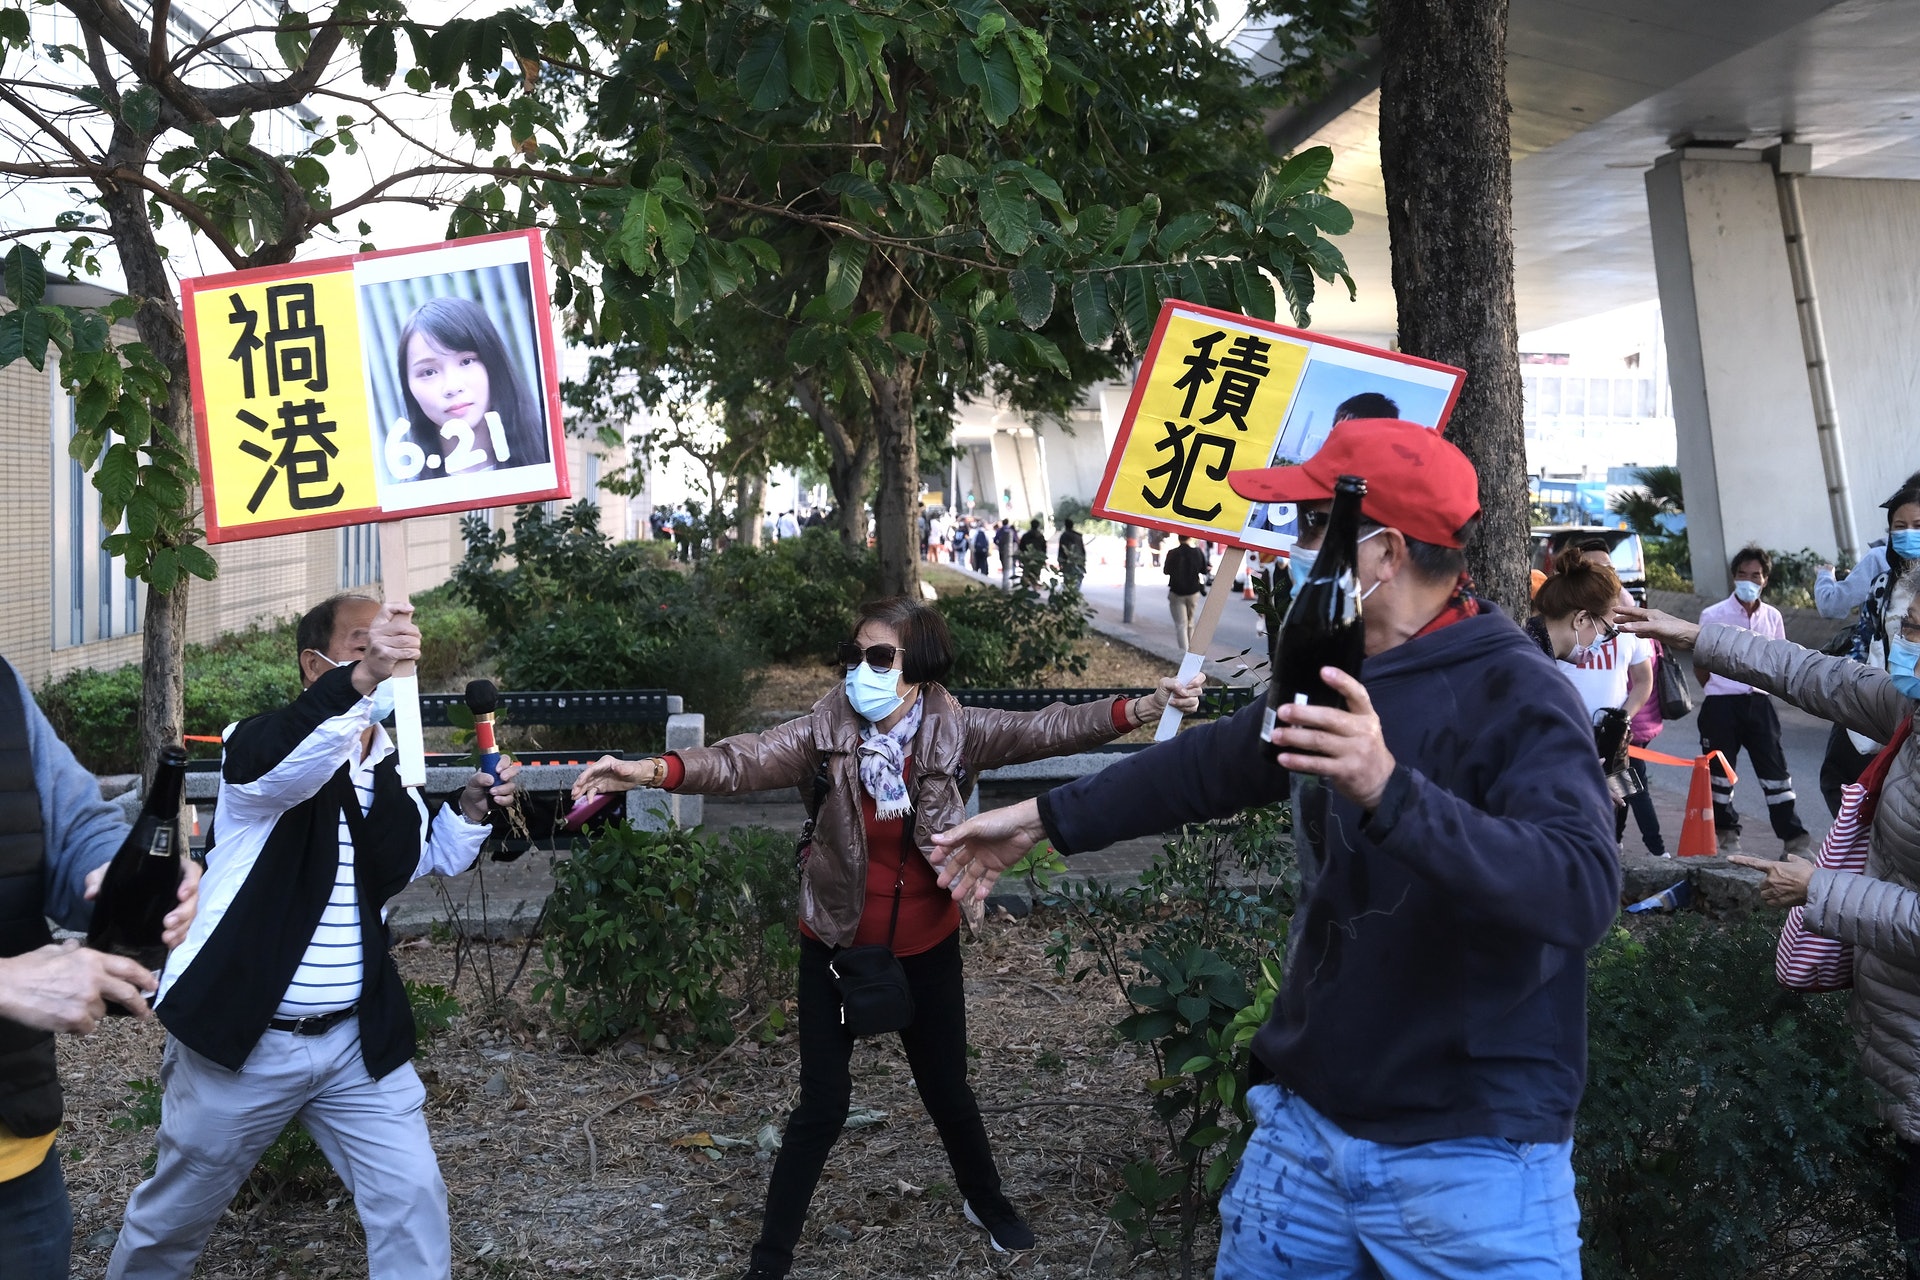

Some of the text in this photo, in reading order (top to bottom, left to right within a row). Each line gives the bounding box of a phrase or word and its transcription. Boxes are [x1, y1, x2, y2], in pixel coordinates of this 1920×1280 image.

[228, 282, 345, 514] 禍港
[384, 410, 511, 480] 6.21
[1141, 330, 1271, 522] 積犯
